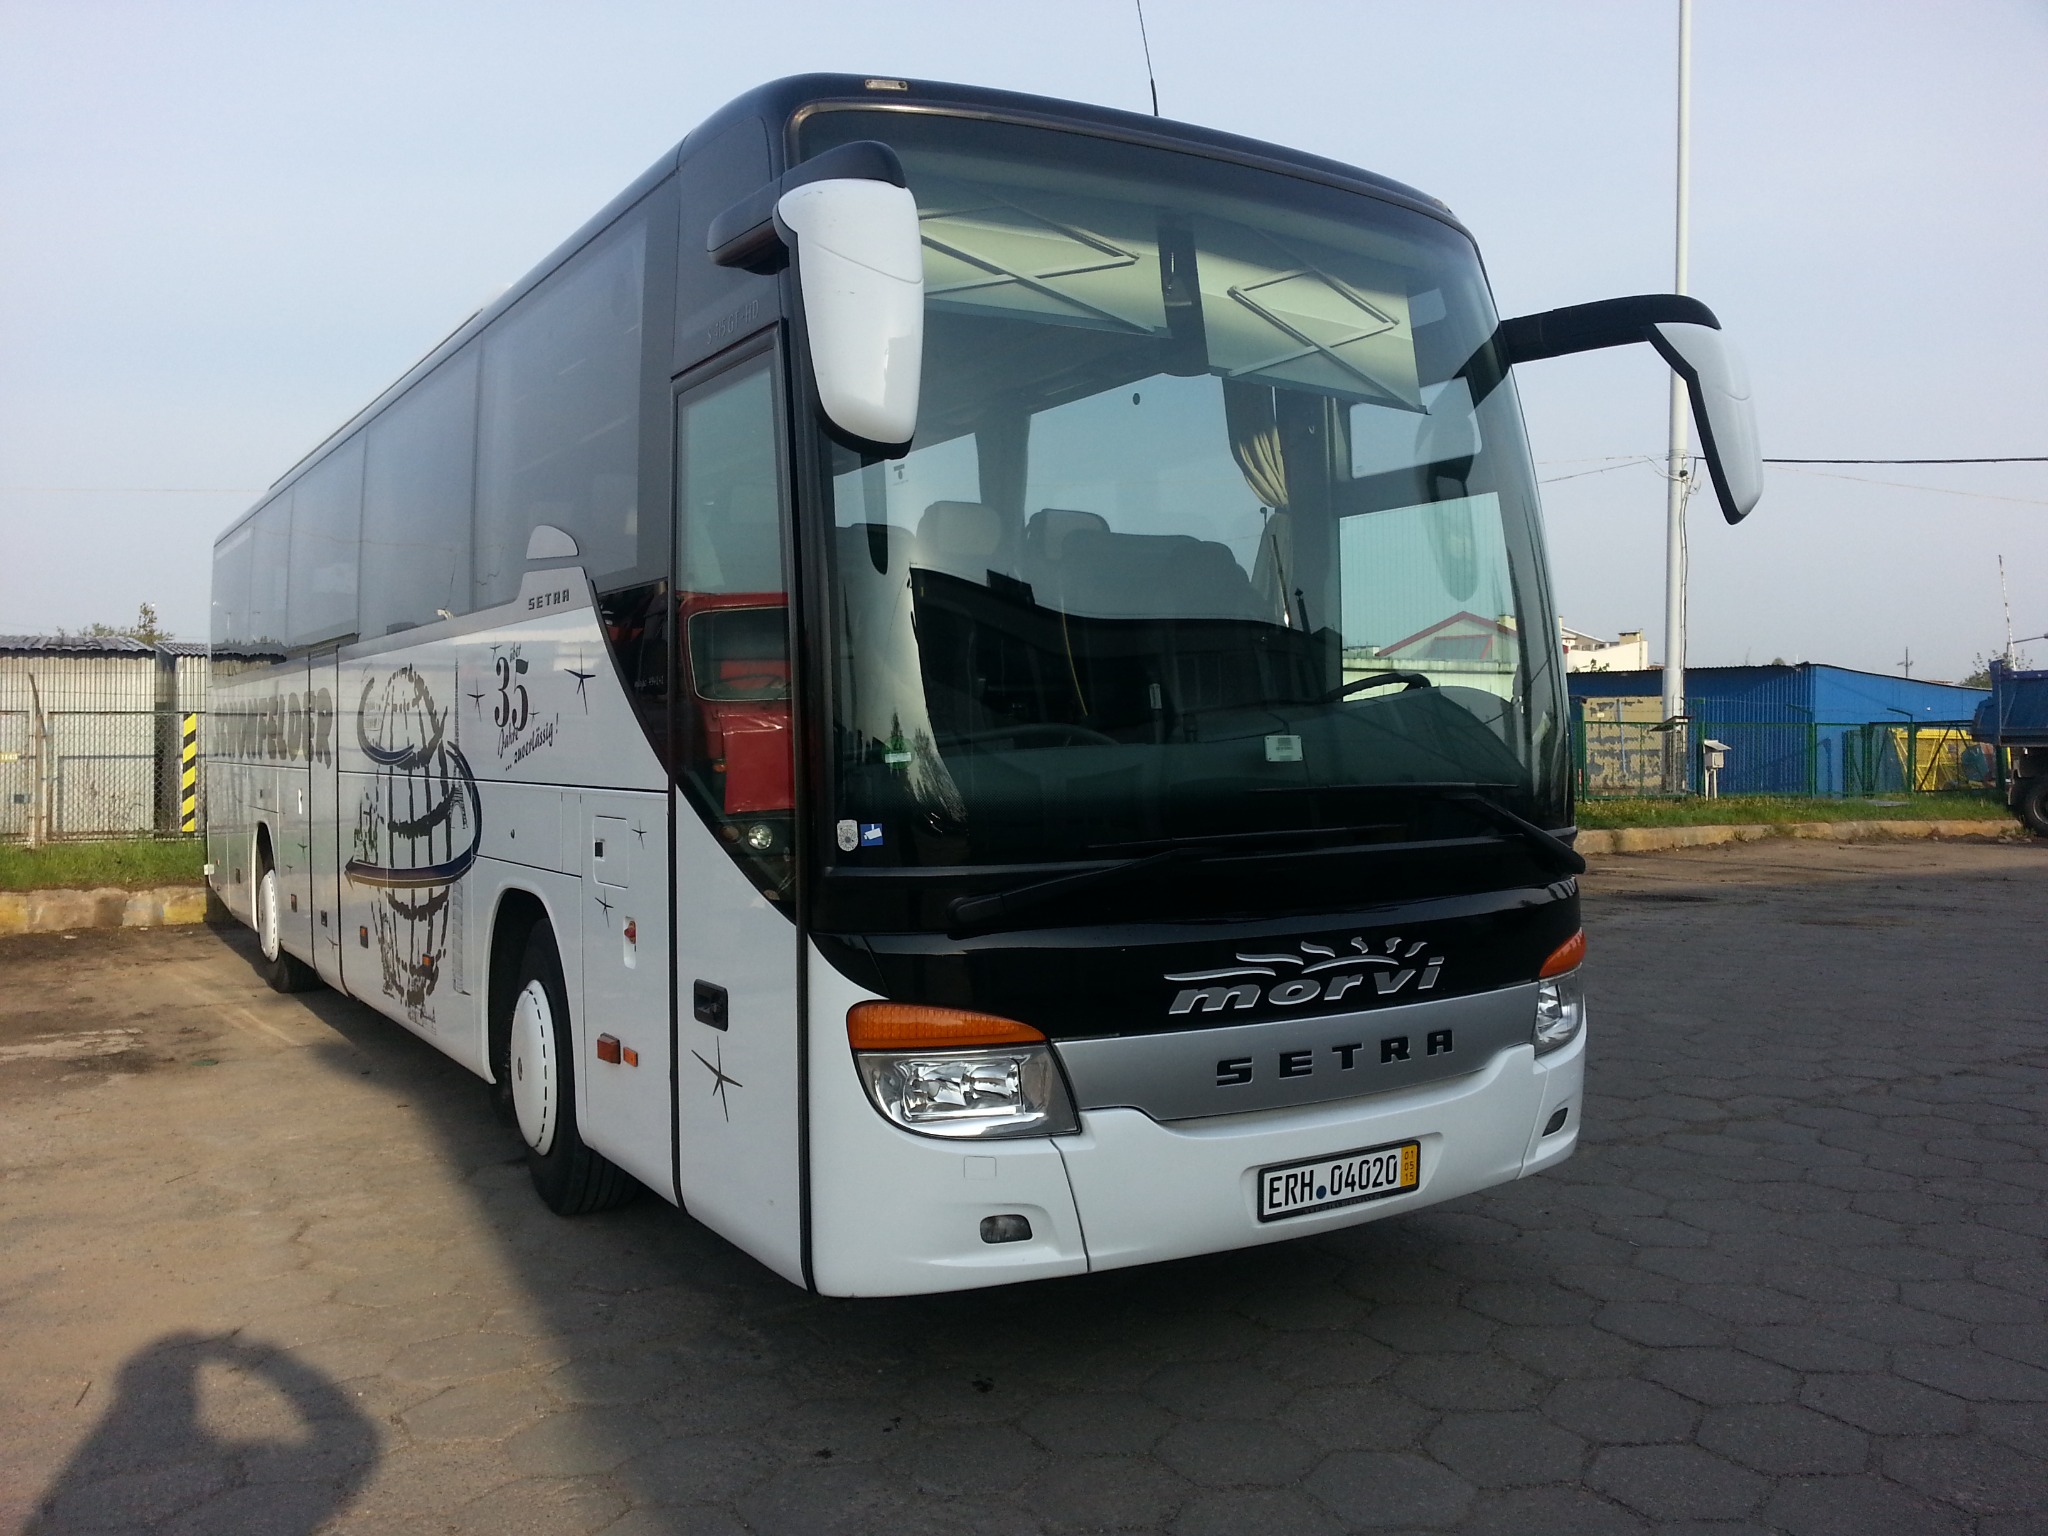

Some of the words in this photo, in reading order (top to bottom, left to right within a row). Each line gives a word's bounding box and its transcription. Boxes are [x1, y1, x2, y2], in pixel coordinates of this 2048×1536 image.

[528, 588, 570, 610] SETRA
[494, 656, 529, 732] 35
[1168, 955, 1445, 1015] morvi
[1216, 1028, 1454, 1088] SETRA
[1404, 1150, 1415, 1160] 01
[1404, 1161, 1415, 1171] 05
[1268, 1169, 1314, 1209] ERH
[1330, 1154, 1398, 1196] 04020
[1405, 1172, 1415, 1182] 15
